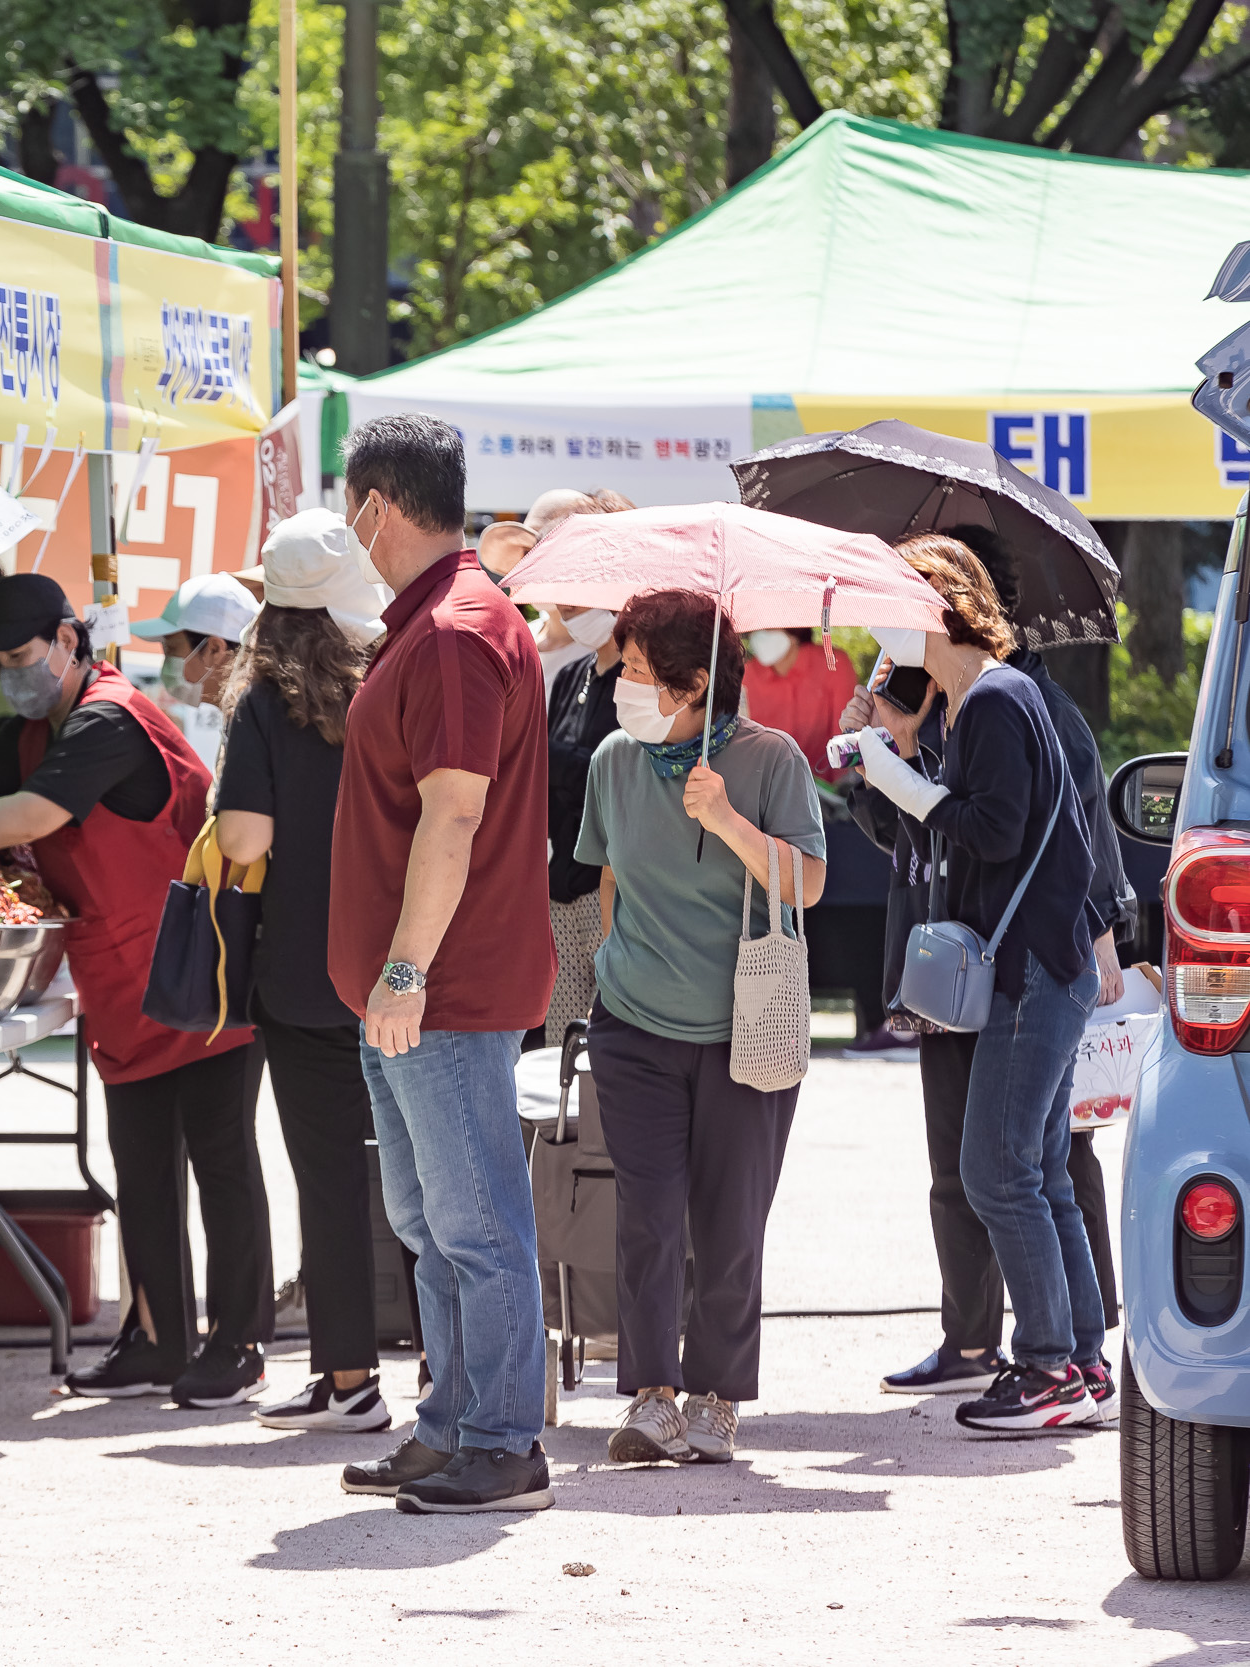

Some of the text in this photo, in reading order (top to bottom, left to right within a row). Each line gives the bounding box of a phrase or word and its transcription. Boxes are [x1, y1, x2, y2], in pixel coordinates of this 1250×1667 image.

[479, 434, 732, 460] 소통하며 발전하는 행복광진
